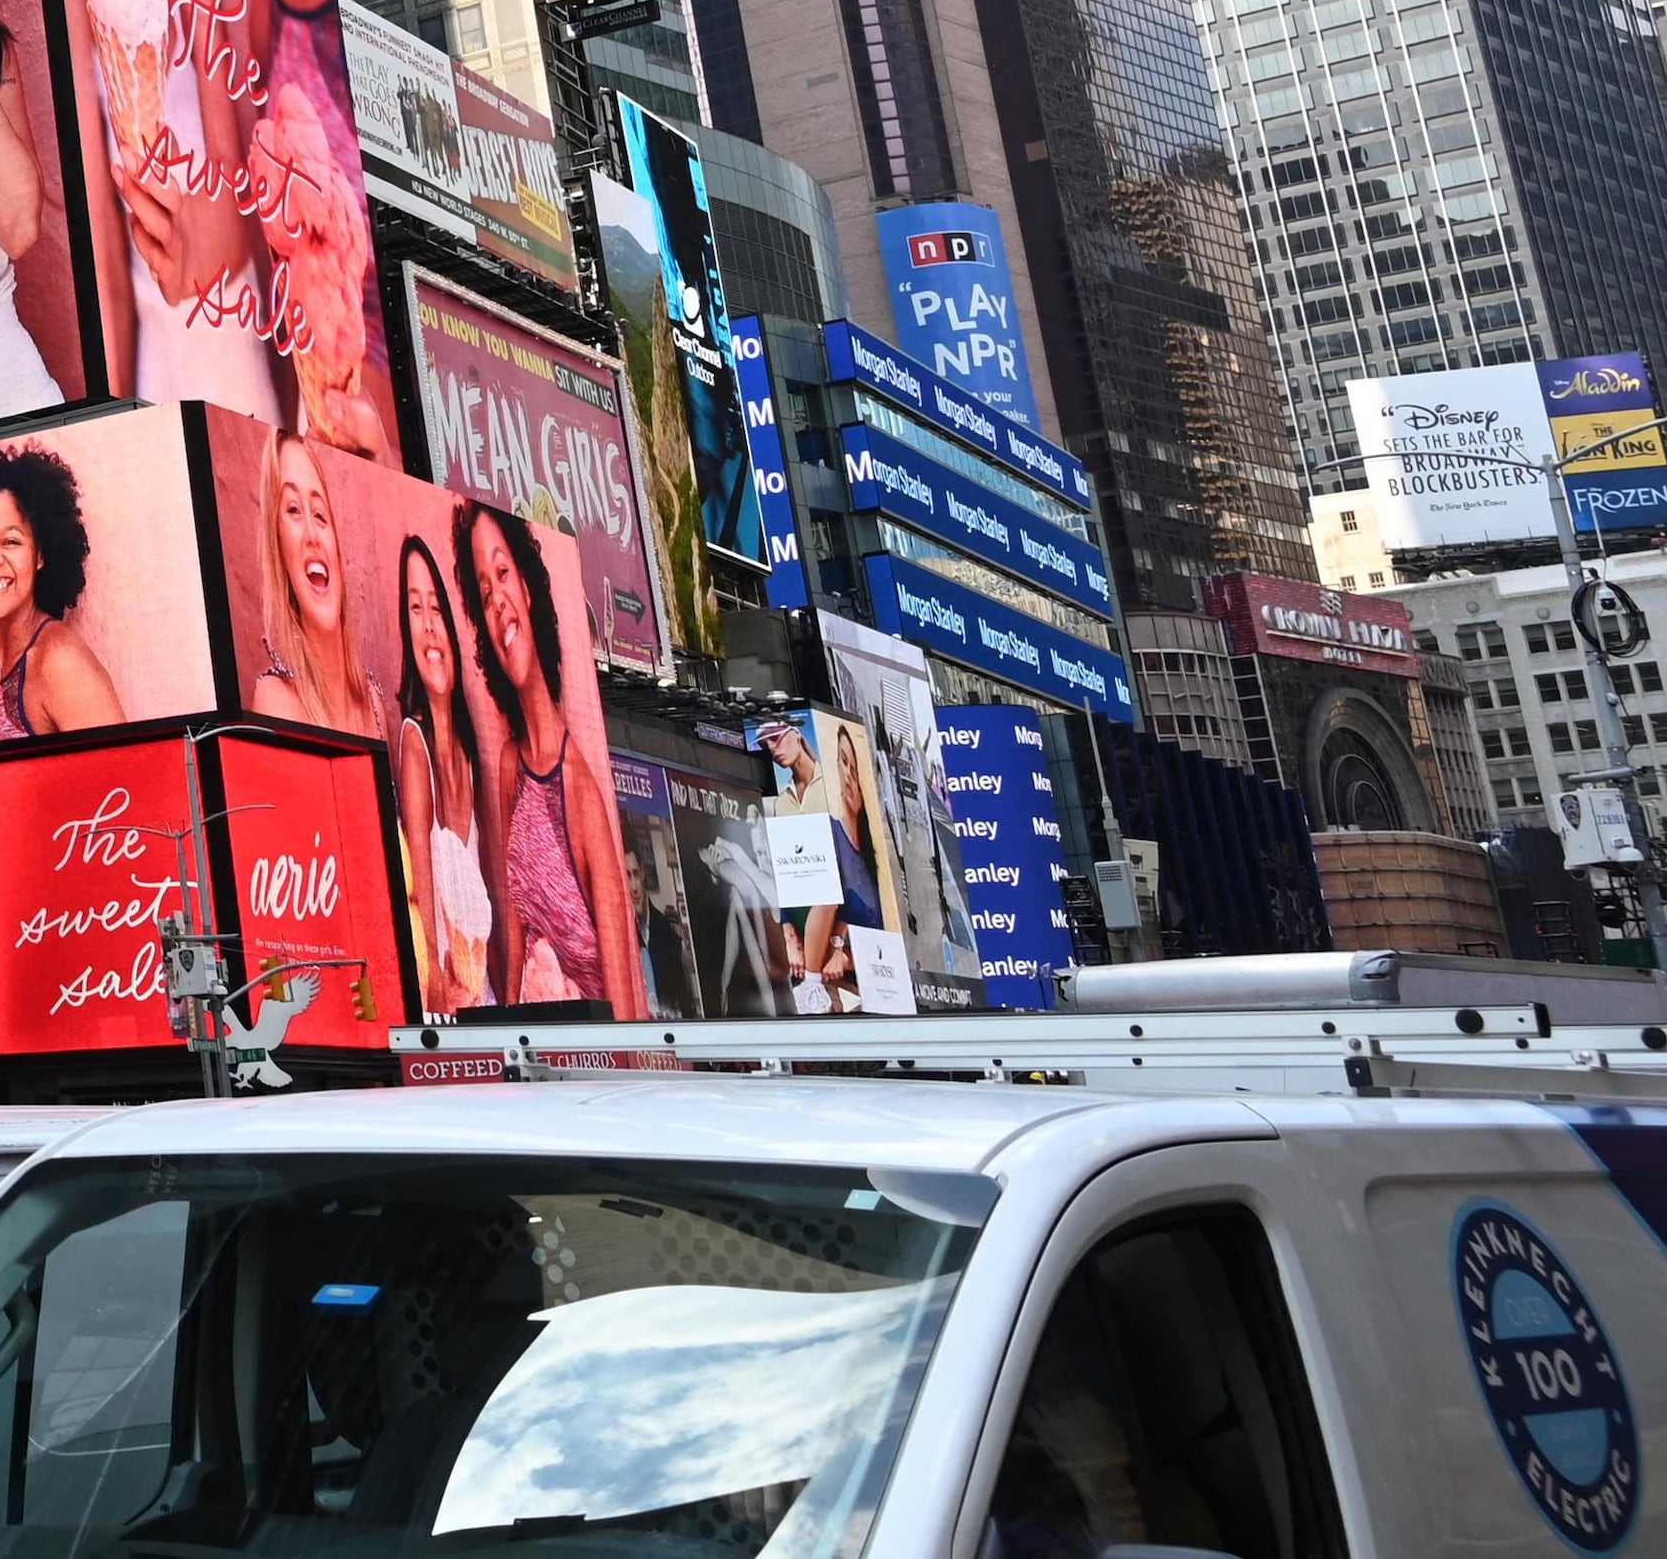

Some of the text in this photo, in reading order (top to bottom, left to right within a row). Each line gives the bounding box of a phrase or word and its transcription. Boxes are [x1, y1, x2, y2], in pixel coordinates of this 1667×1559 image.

[365, 55, 389, 85] PLAY
[369, 77, 398, 110] GOES
[462, 124, 519, 205] JERSEY
[137, 126, 324, 240] sweet
[440, 192, 463, 215] WORLD
[463, 205, 487, 226] STAGES
[917, 237, 986, 260] npr
[184, 257, 315, 358] sale
[441, 311, 480, 348] KNOW
[482, 330, 509, 361] YOU
[510, 343, 555, 383] WANNA
[554, 364, 570, 391] SIT
[571, 374, 598, 404] WITH
[983, 392, 1012, 405] your
[1550, 368, 1641, 399] Aladdin
[1383, 426, 1524, 453] SETS THE BAR FOR
[1592, 426, 1614, 437] THE
[430, 370, 632, 548] MEAN GIRLS
[1611, 438, 1657, 460] KING
[1573, 485, 1667, 514] FROZEN
[947, 771, 1002, 794] anley
[52, 786, 146, 871] The
[249, 831, 340, 922] aerie
[775, 855, 827, 867] SWAROVSKI
[964, 863, 1020, 886] anley
[15, 873, 199, 948] sweet
[982, 955, 1038, 980] anley
[409, 1058, 503, 1081] COFFEED
[557, 1052, 617, 1070] CHURROS
[1463, 1219, 1617, 1389] KLEINKNECHT
[1515, 1348, 1582, 1402] 100
[1526, 1448, 1632, 1535] ELECTRIC
